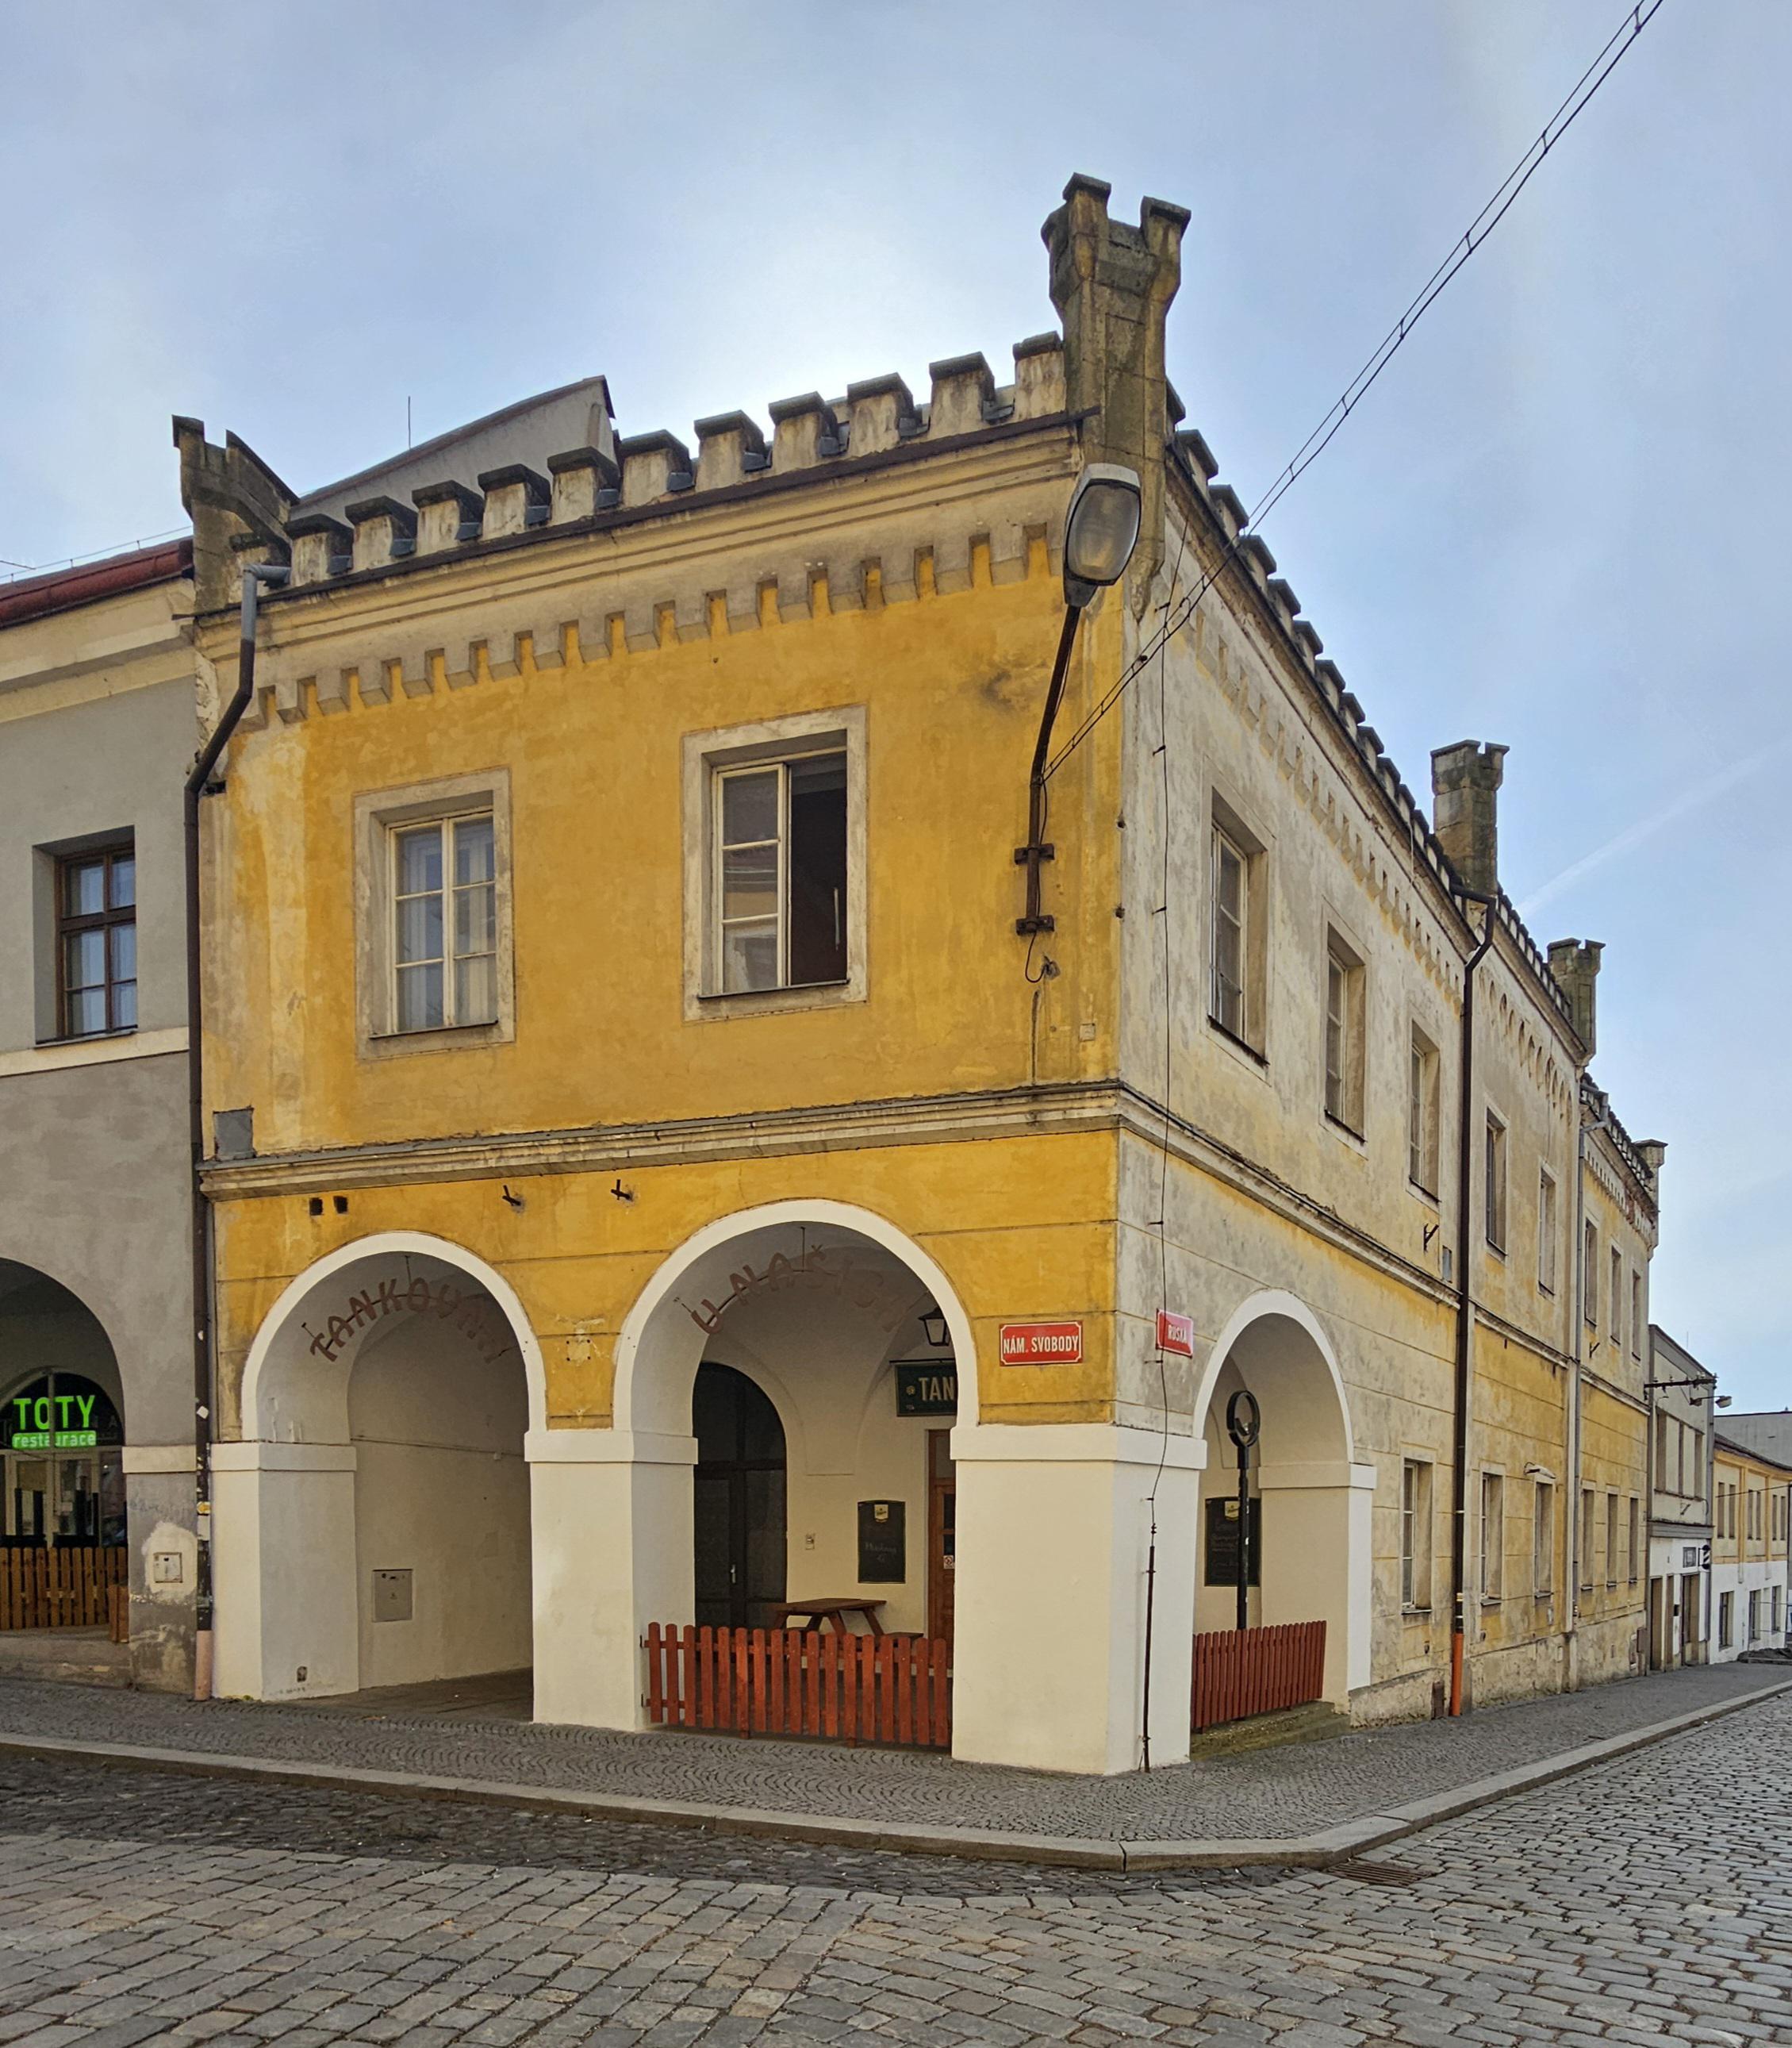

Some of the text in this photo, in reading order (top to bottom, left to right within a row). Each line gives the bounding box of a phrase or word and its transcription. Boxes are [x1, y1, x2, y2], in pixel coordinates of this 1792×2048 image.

[1003, 1335, 1079, 1354] NÁM. SVOBODY
[13, 1395, 95, 1431] TOTY
